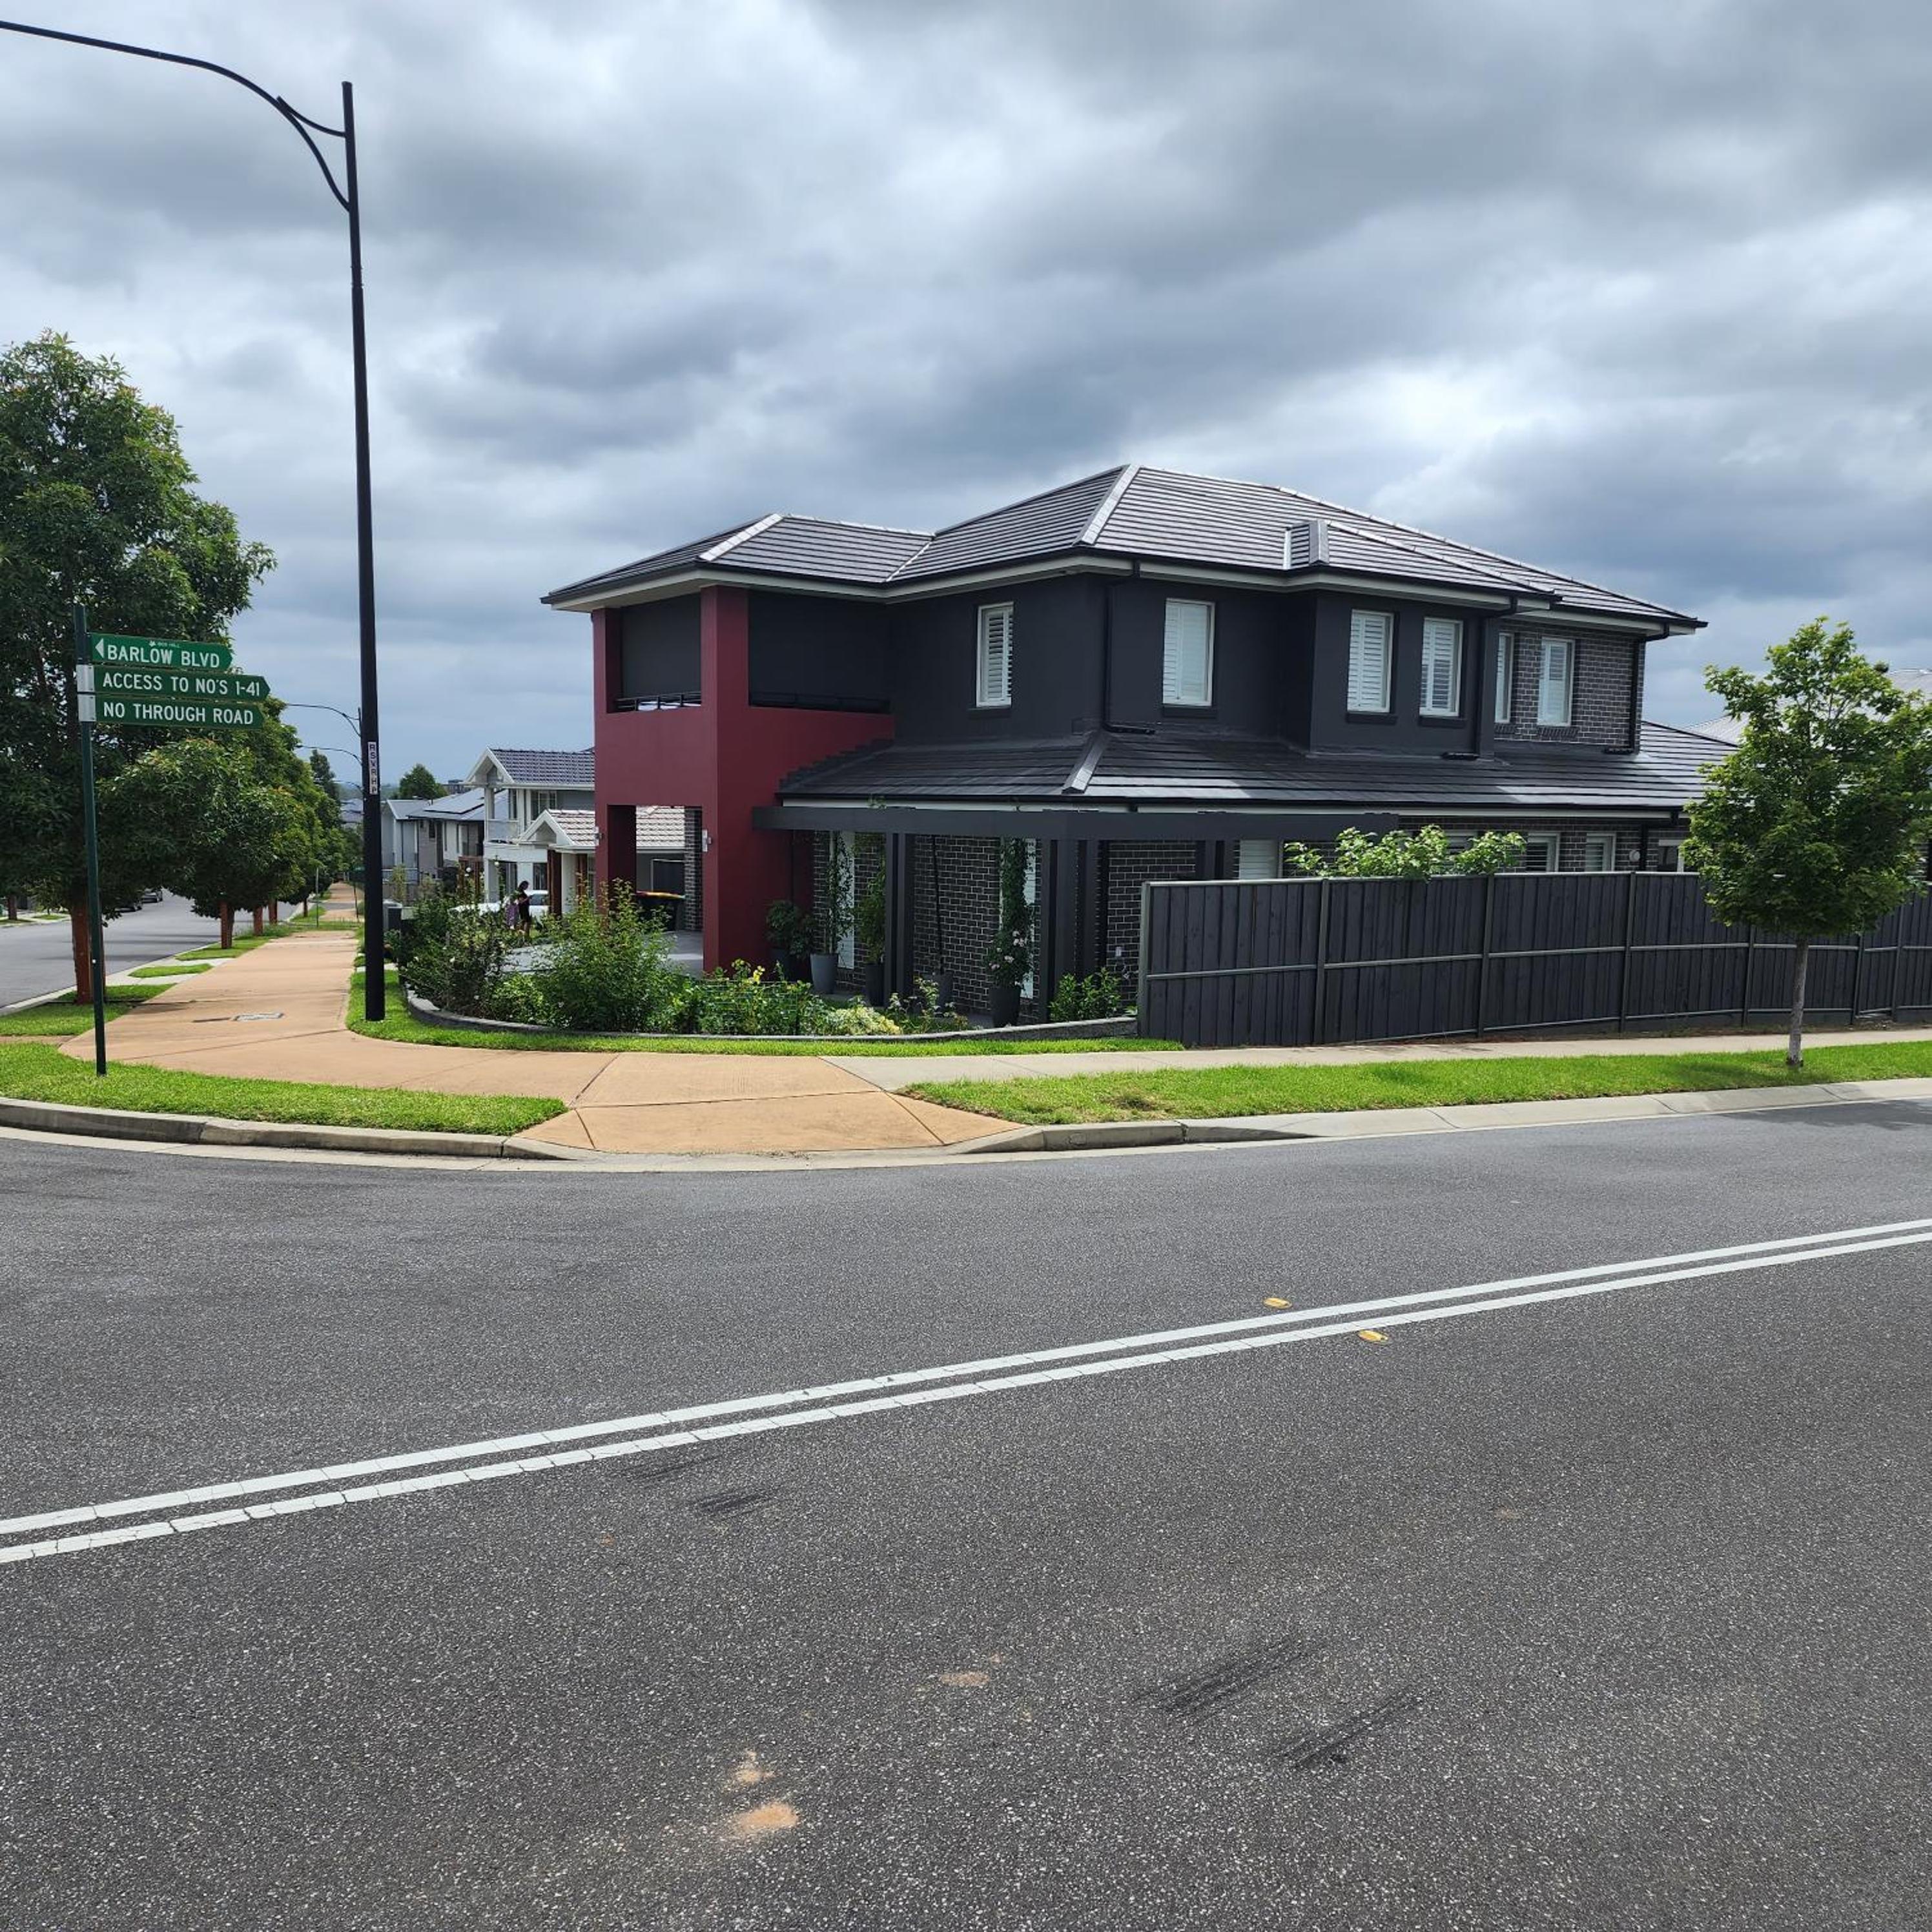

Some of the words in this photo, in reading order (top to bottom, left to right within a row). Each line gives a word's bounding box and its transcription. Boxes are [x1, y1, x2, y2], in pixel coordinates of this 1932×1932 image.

[107, 645, 173, 665] BARLOW
[181, 651, 220, 668] BLVD
[103, 672, 163, 691] ACCESS
[170, 677, 189, 693] TO
[196, 679, 228, 695] NO'S
[236, 681, 260, 696] 1-41
[103, 702, 125, 718] NO
[133, 704, 206, 723] THROUGH
[213, 708, 253, 724] ROAD
